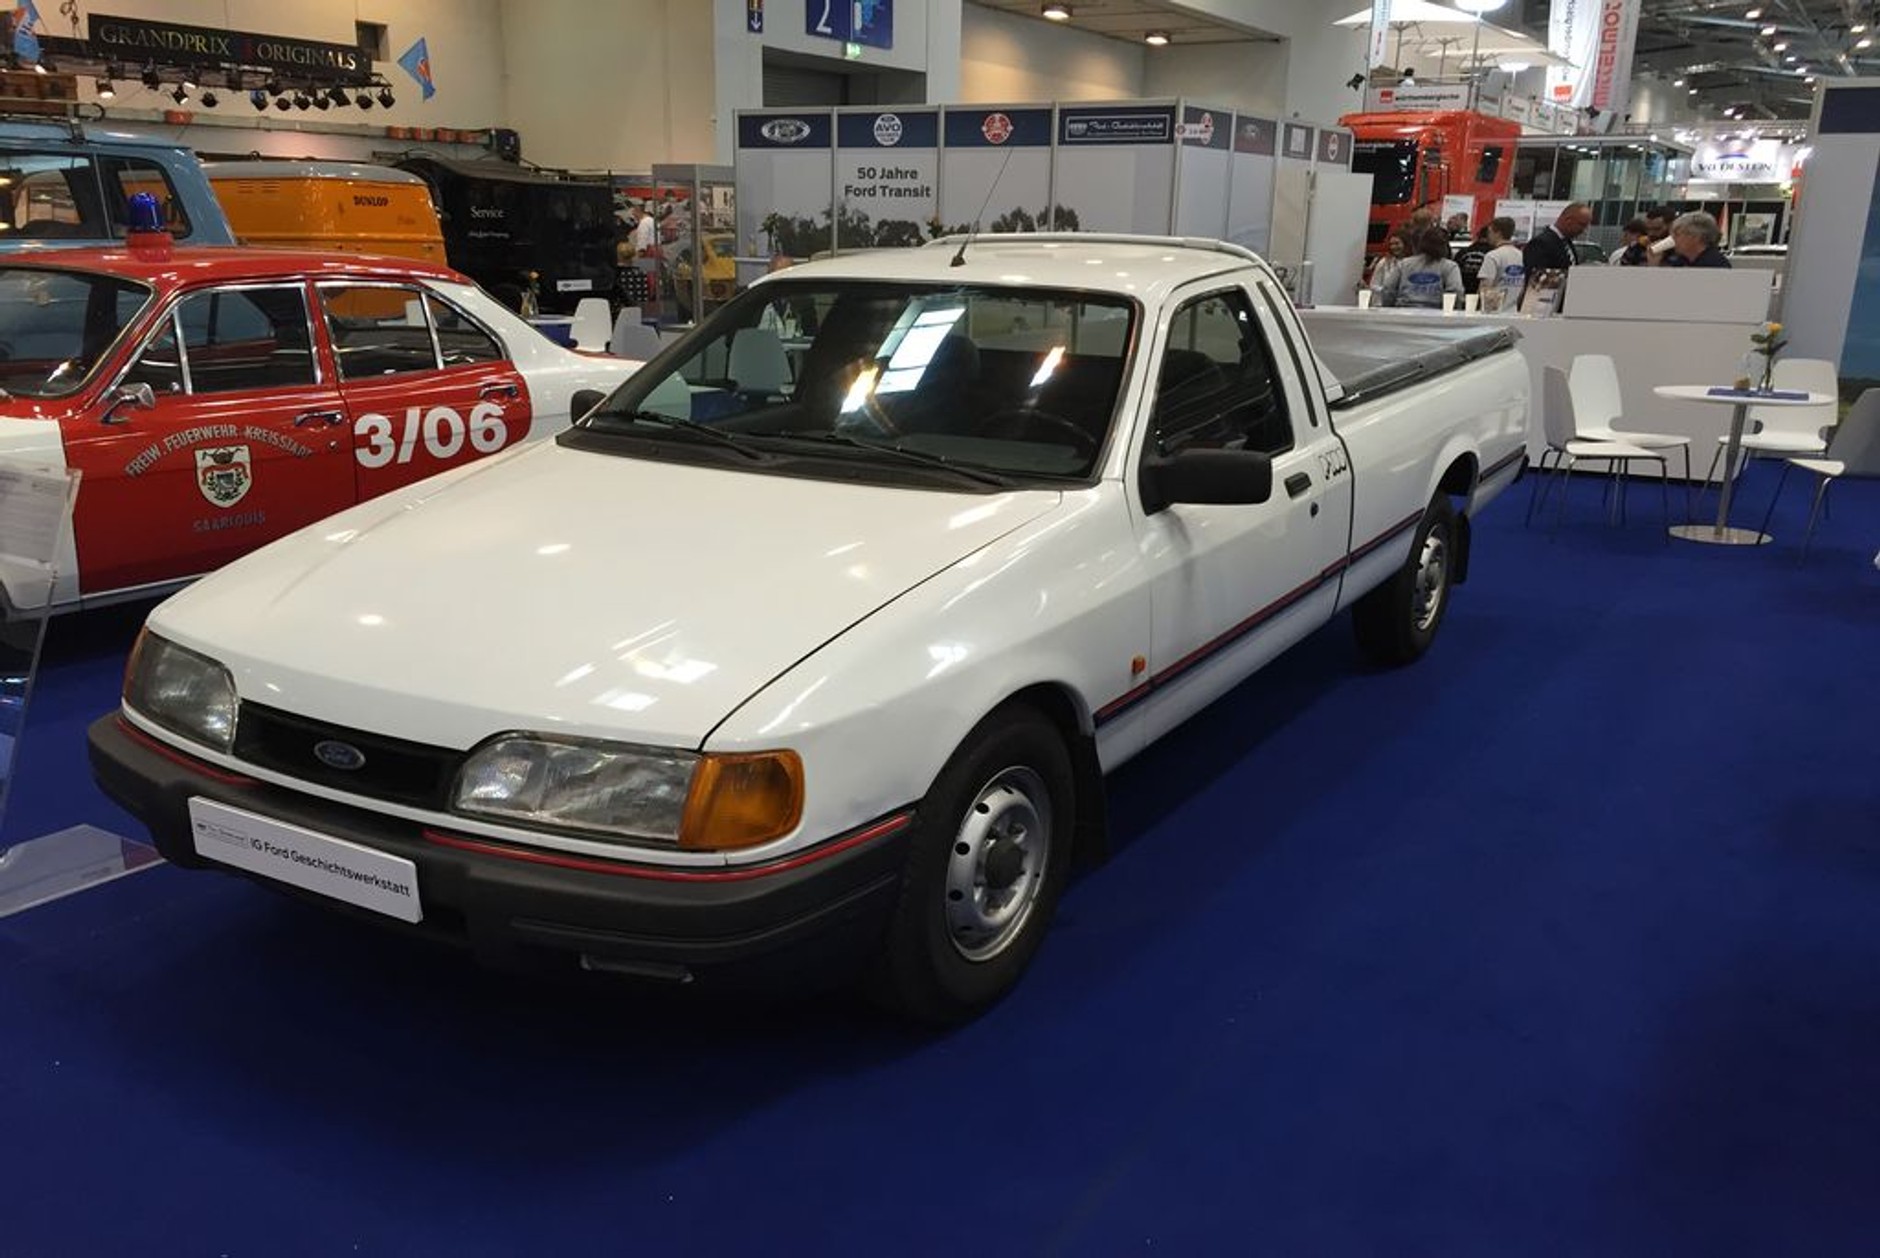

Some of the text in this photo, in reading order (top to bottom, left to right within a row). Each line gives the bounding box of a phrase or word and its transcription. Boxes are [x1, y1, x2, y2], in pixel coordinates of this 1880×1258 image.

[100, 23, 356, 71] GRANDPRIX ORIGINALS
[857, 166, 918, 180] 50 Jahre
[353, 196, 389, 207] DUNLOP
[844, 184, 932, 198] Ford Transit
[470, 205, 505, 218] Service
[163, 423, 238, 452] FEUERWEHR
[354, 401, 508, 469] 3/06
[192, 509, 266, 532] SAARLOUIS
[250, 838, 411, 897] IG Ford Geschichtswerkstatt
